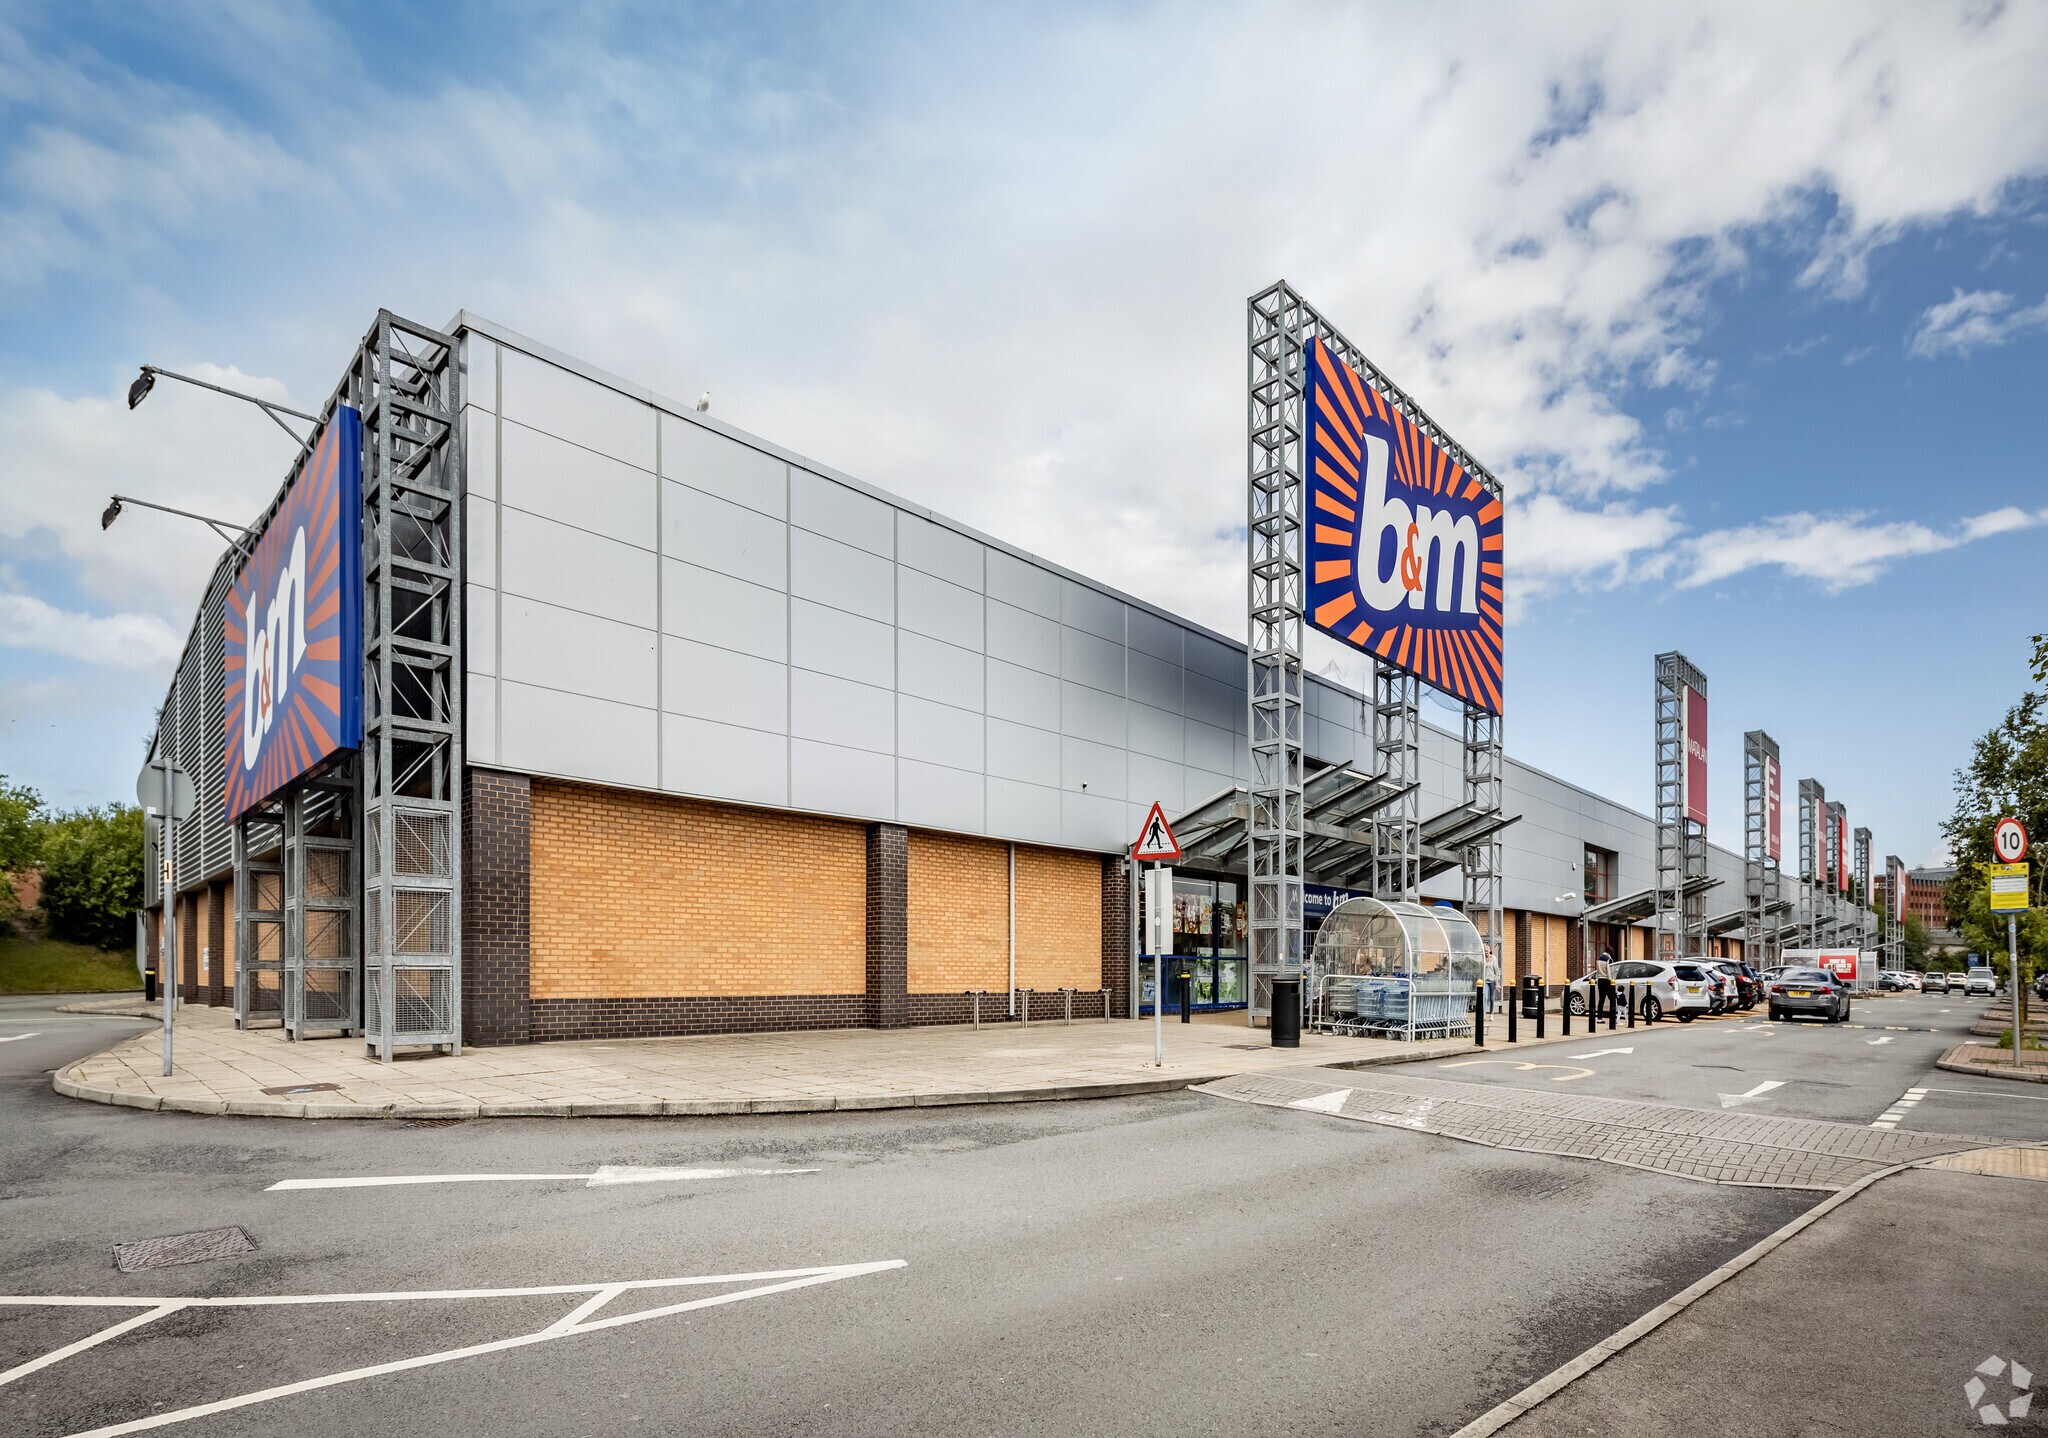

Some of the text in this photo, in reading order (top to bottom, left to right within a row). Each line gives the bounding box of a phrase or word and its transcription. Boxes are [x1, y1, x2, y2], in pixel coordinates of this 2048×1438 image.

[1358, 433, 1479, 614] b&m
[244, 526, 307, 771] b&m
[2001, 831, 2020, 850] 10
[1324, 893, 1332, 906] to
